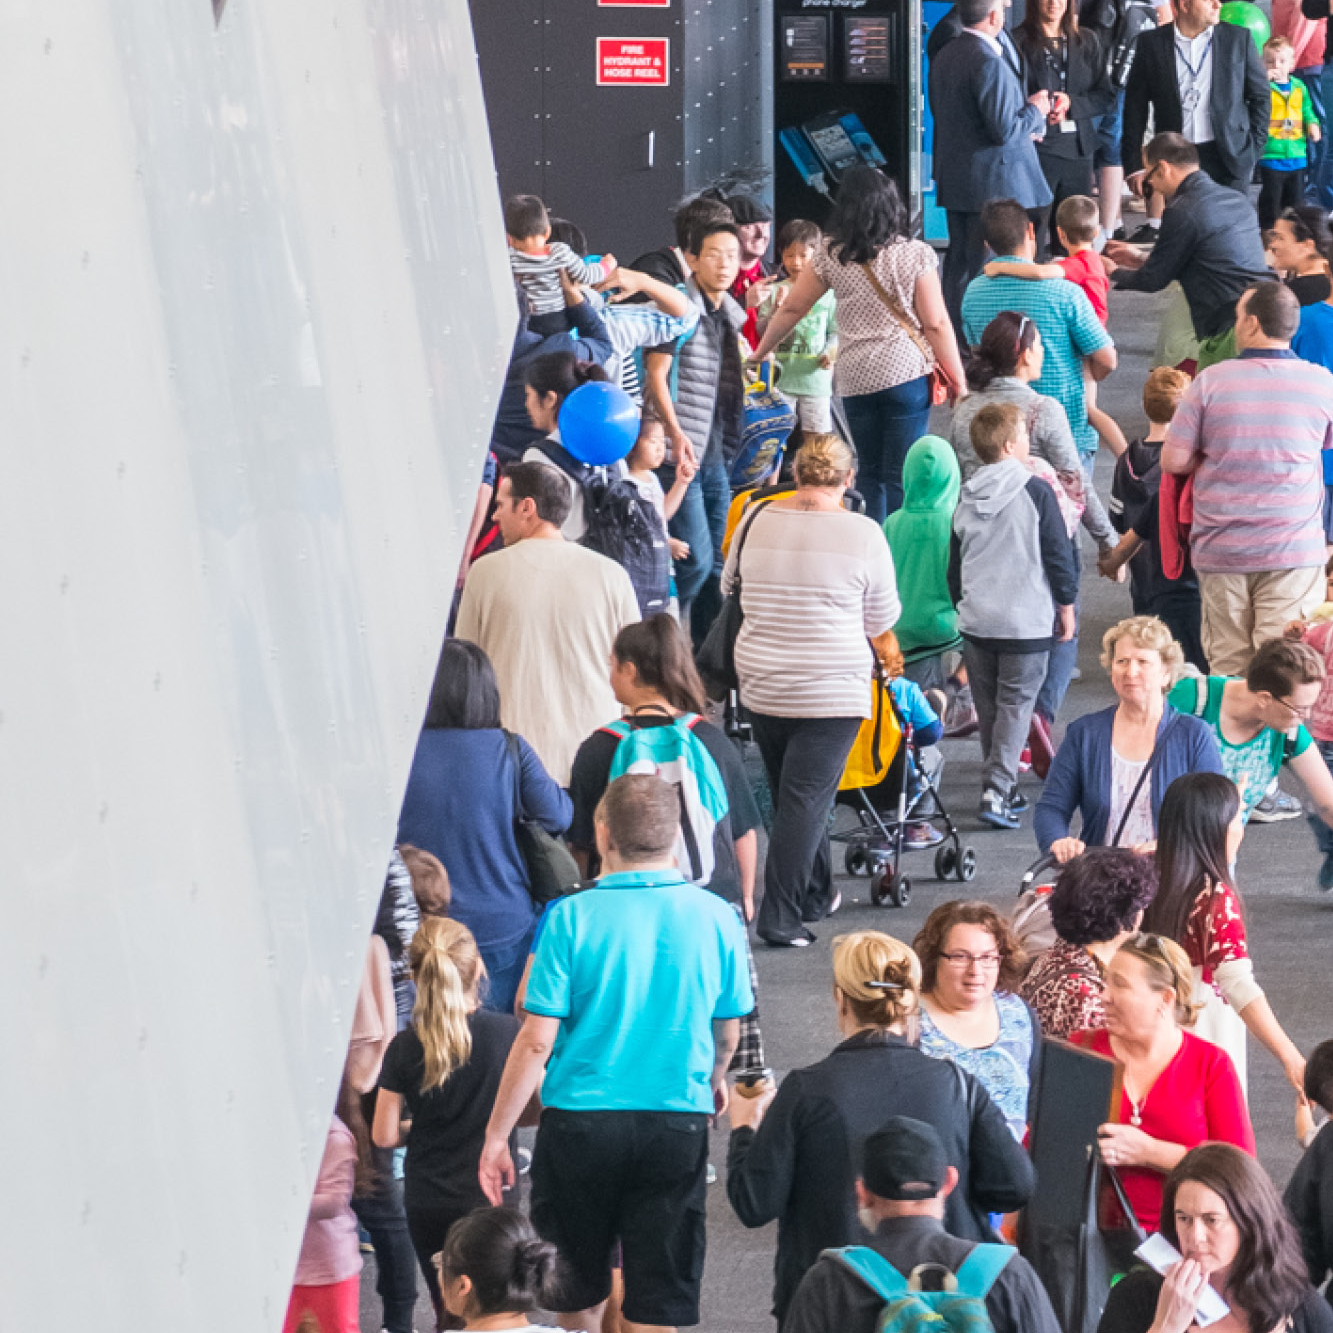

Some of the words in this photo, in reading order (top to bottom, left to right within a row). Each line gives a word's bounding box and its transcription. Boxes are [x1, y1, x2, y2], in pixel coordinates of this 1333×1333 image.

[802, 0, 830, 7] phone
[831, 0, 867, 9] charger
[620, 44, 644, 55] FIRE
[603, 56, 651, 66] HYDRANT
[652, 57, 662, 66] &
[603, 68, 633, 78] HOSE
[634, 68, 661, 78] REEL
